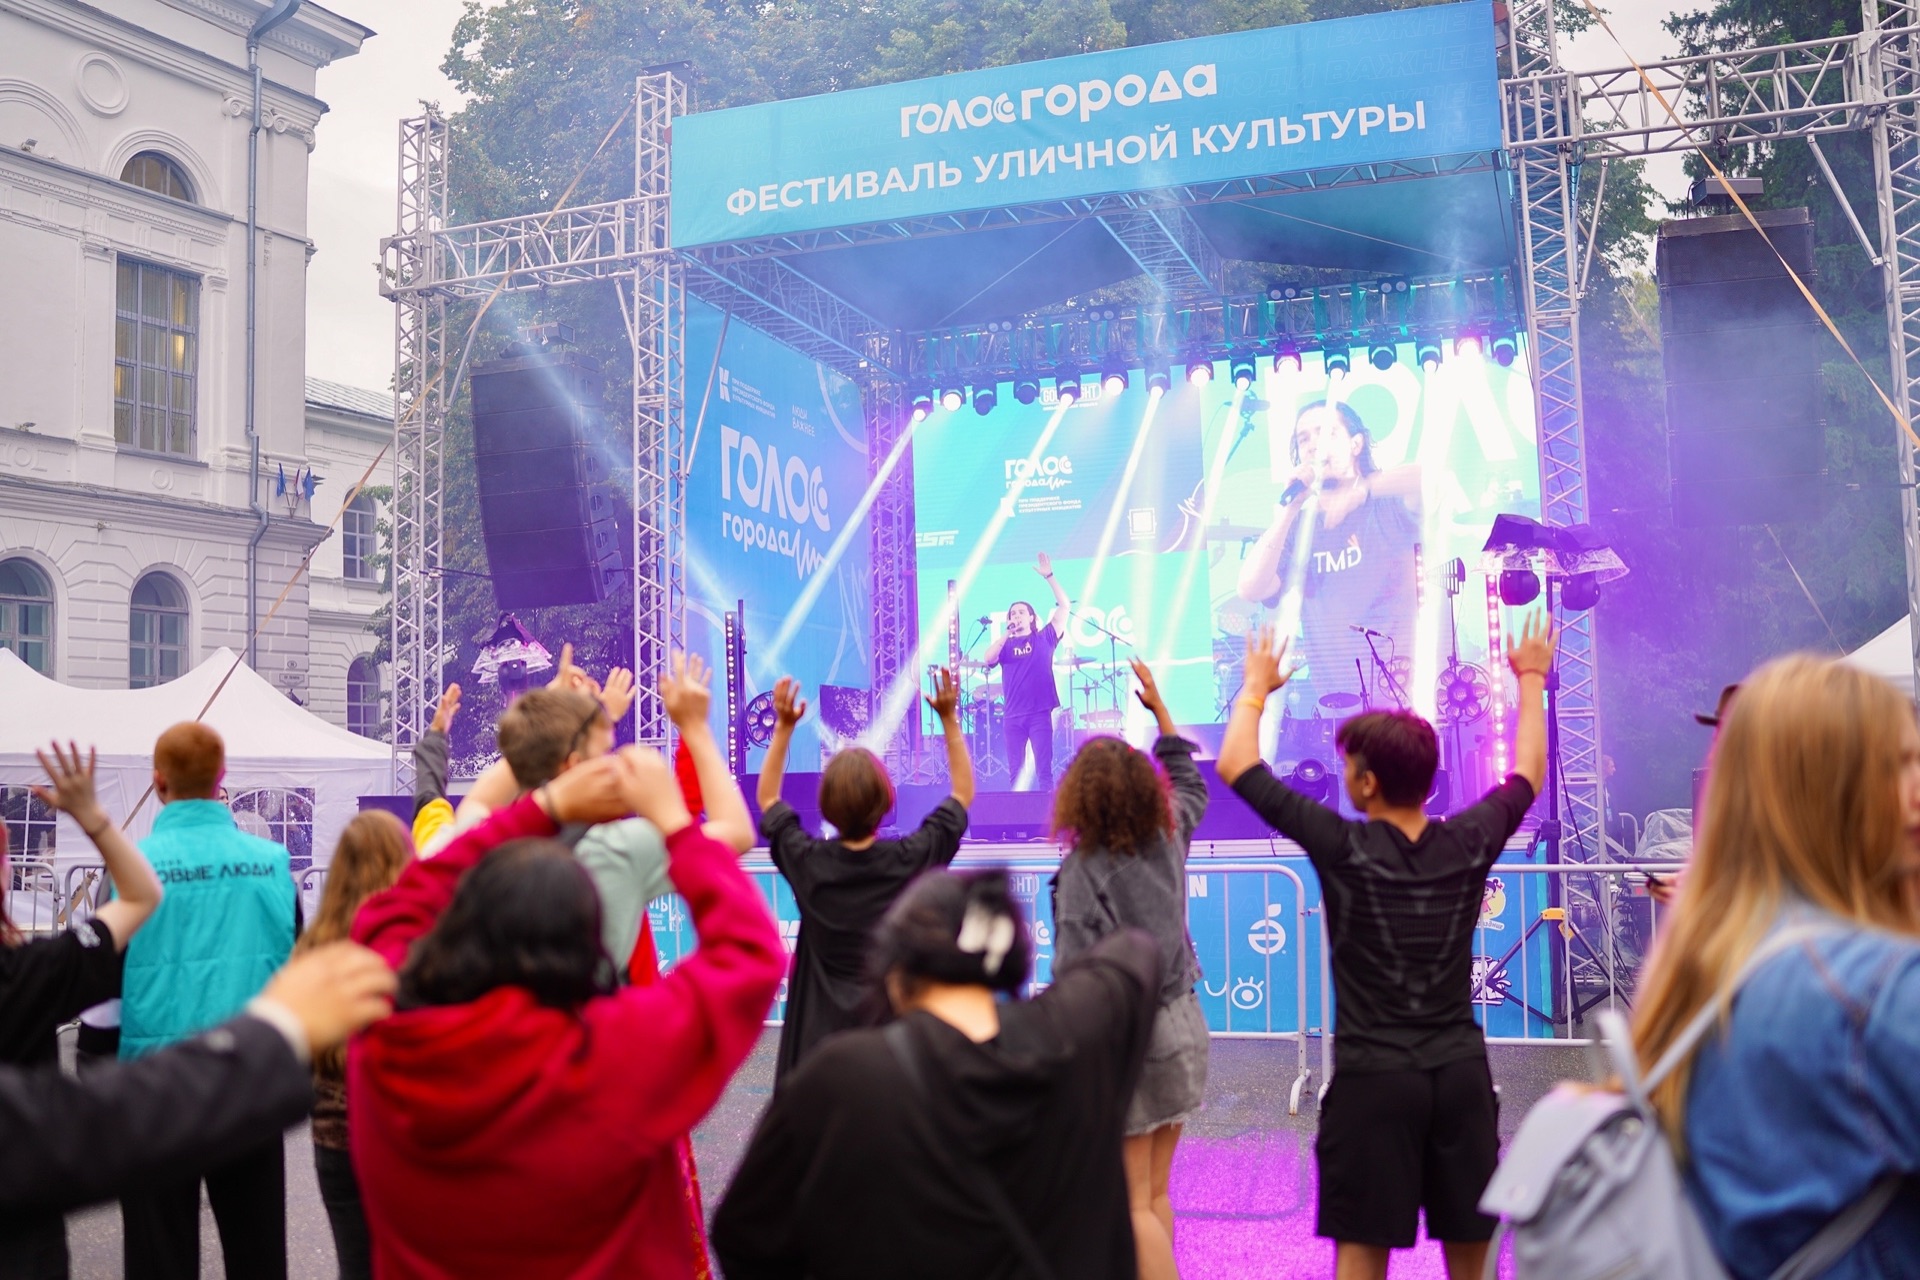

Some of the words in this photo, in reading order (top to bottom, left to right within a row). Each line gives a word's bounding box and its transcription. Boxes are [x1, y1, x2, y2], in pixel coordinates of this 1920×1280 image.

[900, 92, 1018, 138] ГОЛОС
[1021, 63, 1218, 123] города
[726, 160, 962, 217] ФЕСТИВАЛЬ
[972, 123, 1177, 183] УЛИЧНОЙ
[1192, 100, 1427, 157] КУЛЬТУРЫ
[720, 424, 831, 532] ГОЛОС
[1004, 455, 1073, 480] ГОЛОС
[722, 511, 795, 558] города
[156, 864, 215, 884] ОВЫЕ
[219, 861, 277, 880] ЛЮДИ
